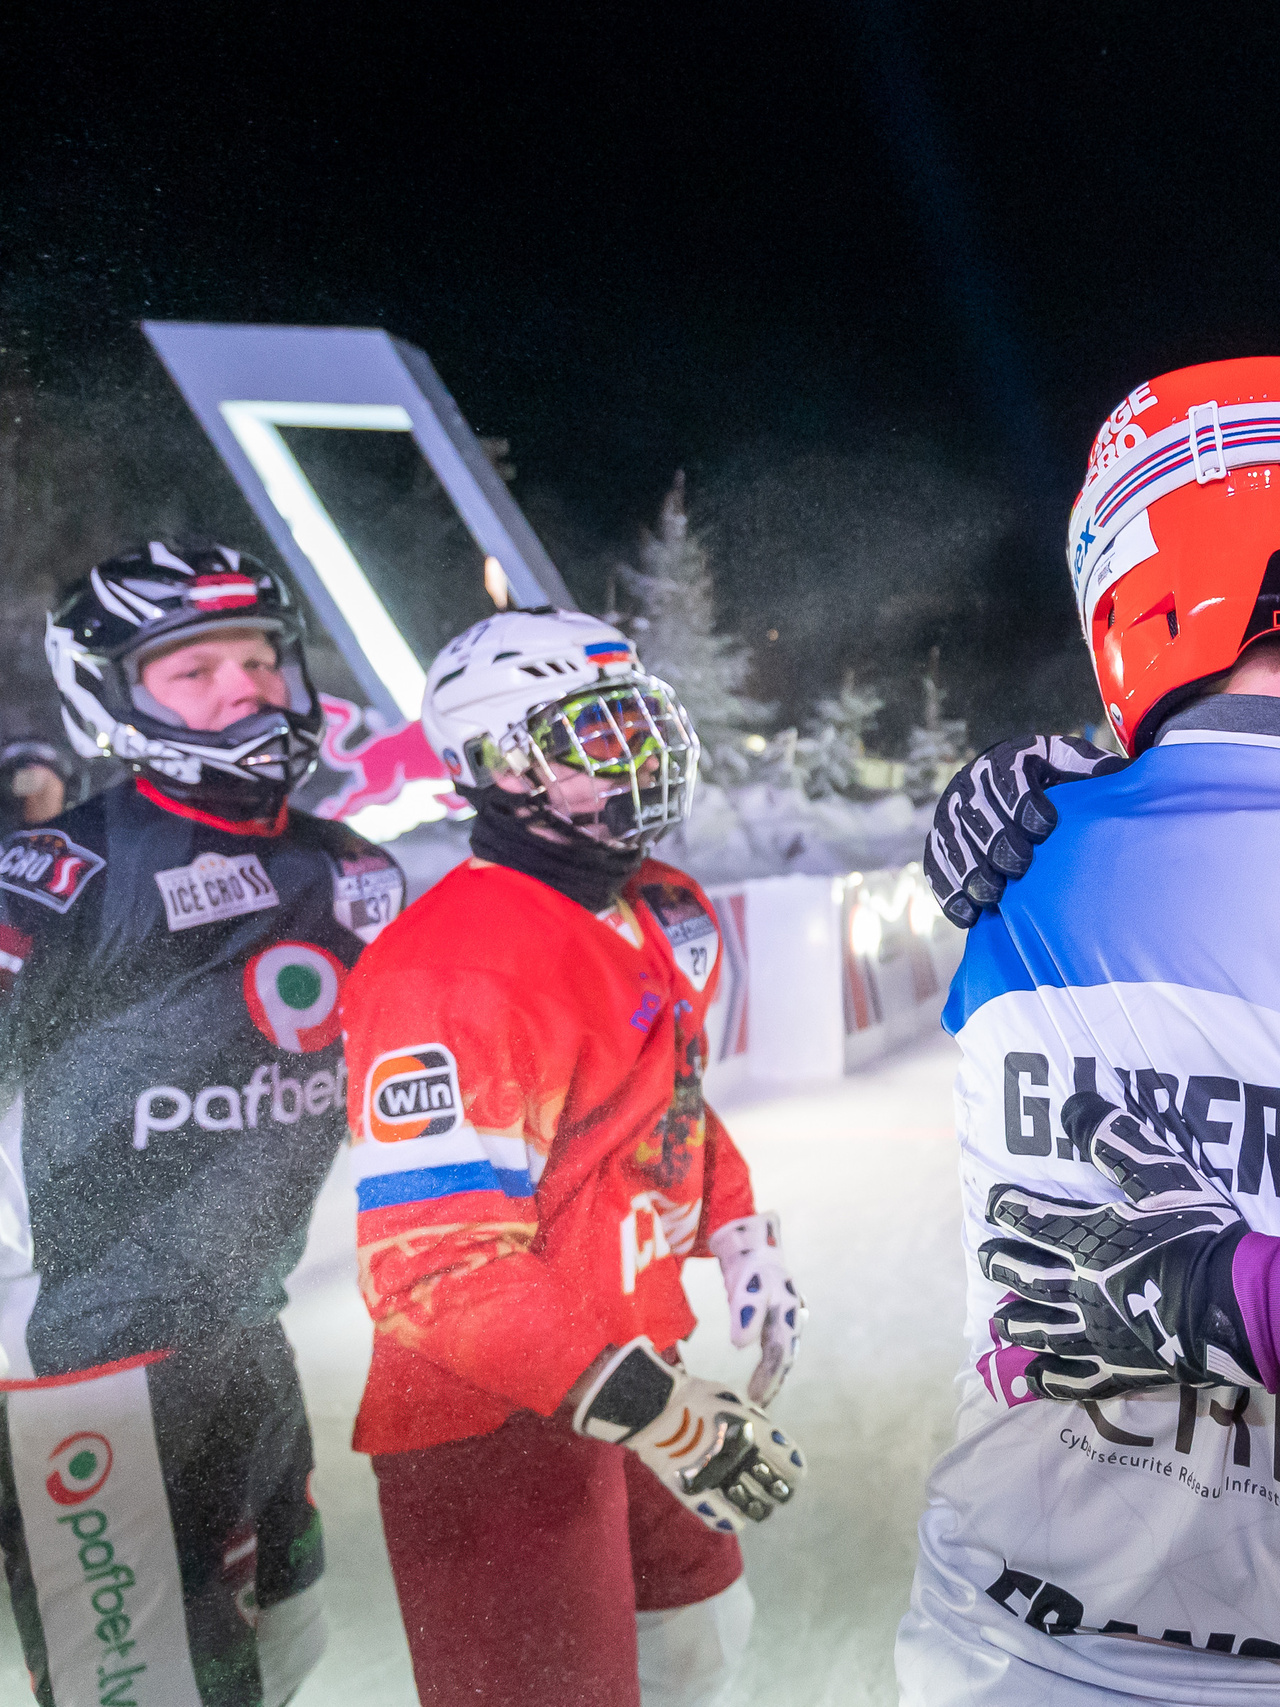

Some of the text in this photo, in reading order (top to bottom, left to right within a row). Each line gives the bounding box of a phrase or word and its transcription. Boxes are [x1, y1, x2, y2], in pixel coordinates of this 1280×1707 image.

[168, 865, 270, 916] ICE CROSS
[1059, 1427, 1173, 1478] Cybersécurité
[1178, 1465, 1222, 1499] Réseau
